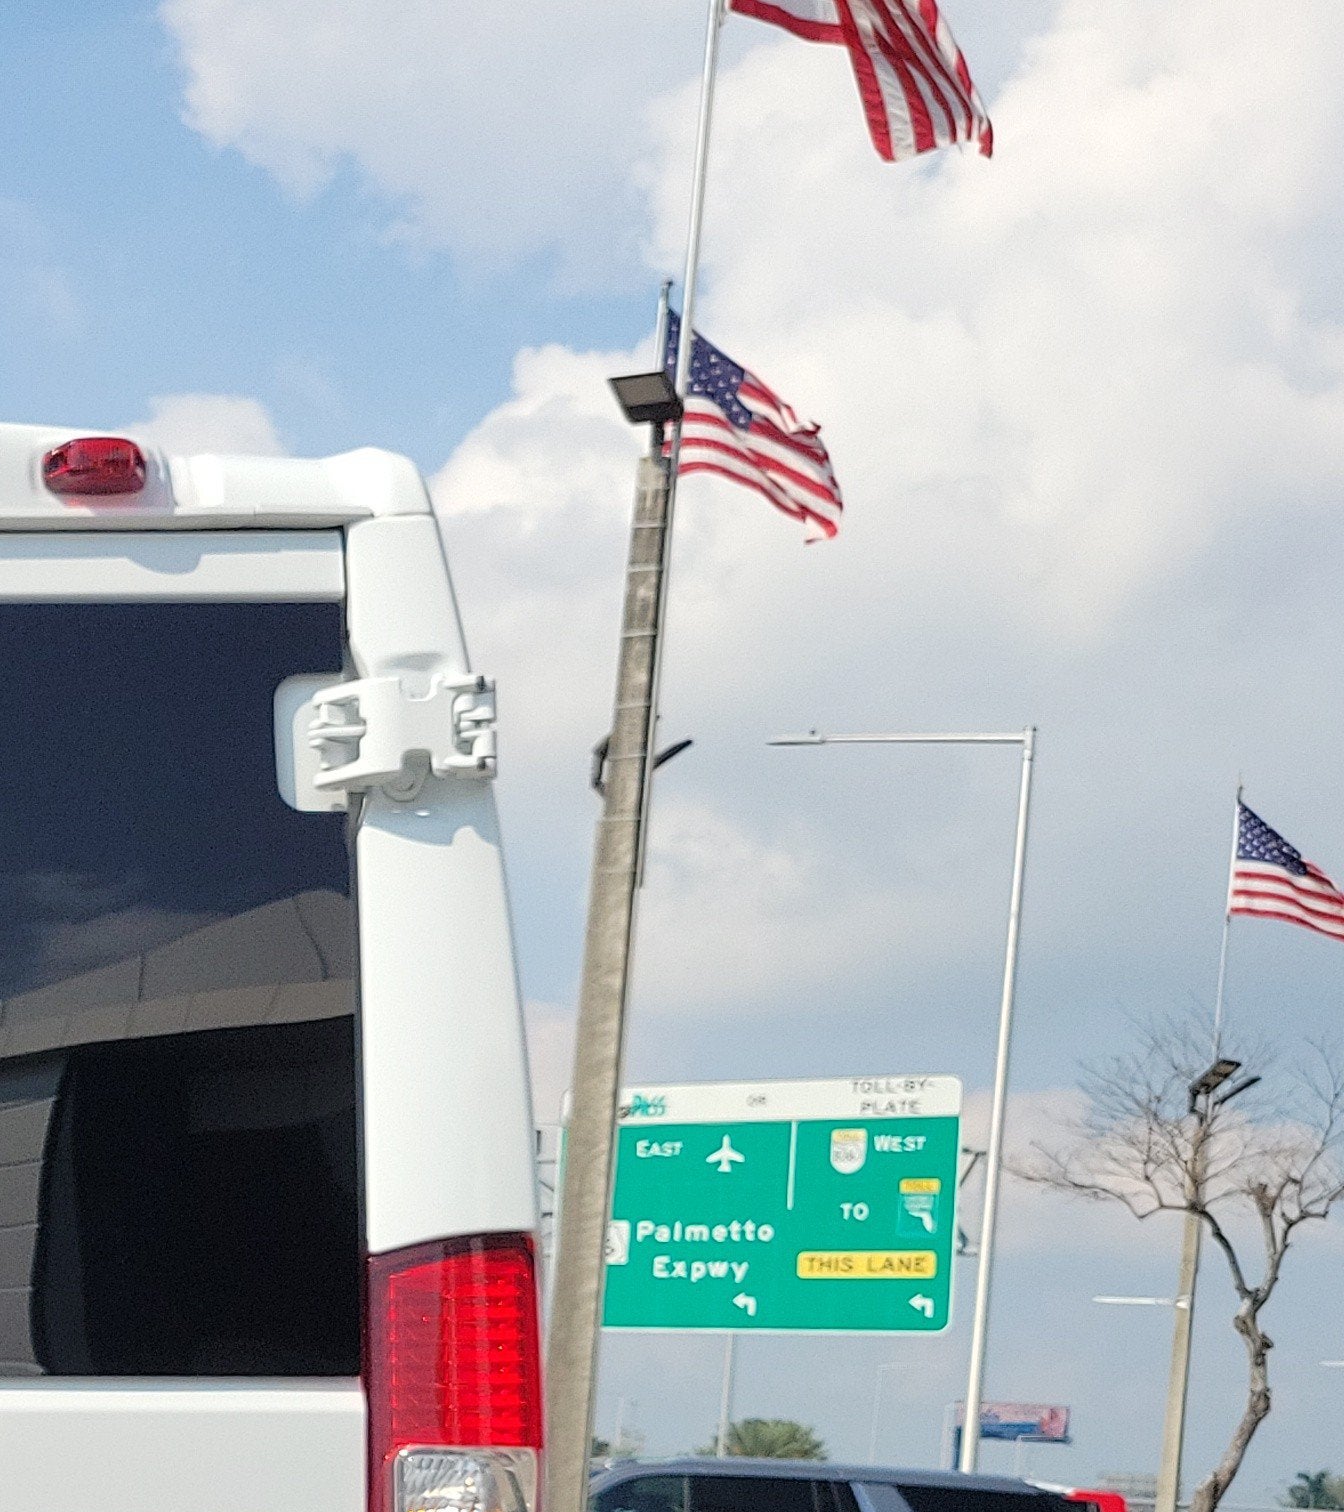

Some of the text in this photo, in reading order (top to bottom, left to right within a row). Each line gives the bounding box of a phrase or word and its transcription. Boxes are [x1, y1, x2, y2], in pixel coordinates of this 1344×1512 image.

[860, 1101, 920, 1115] PLATE
[636, 1139, 683, 1158] EAST
[873, 1135, 927, 1152] WEST
[840, 1202, 869, 1221] TO
[636, 1219, 775, 1243] Palmetto
[652, 1255, 749, 1283] Expwy
[806, 1256, 928, 1273] THIS LANE
